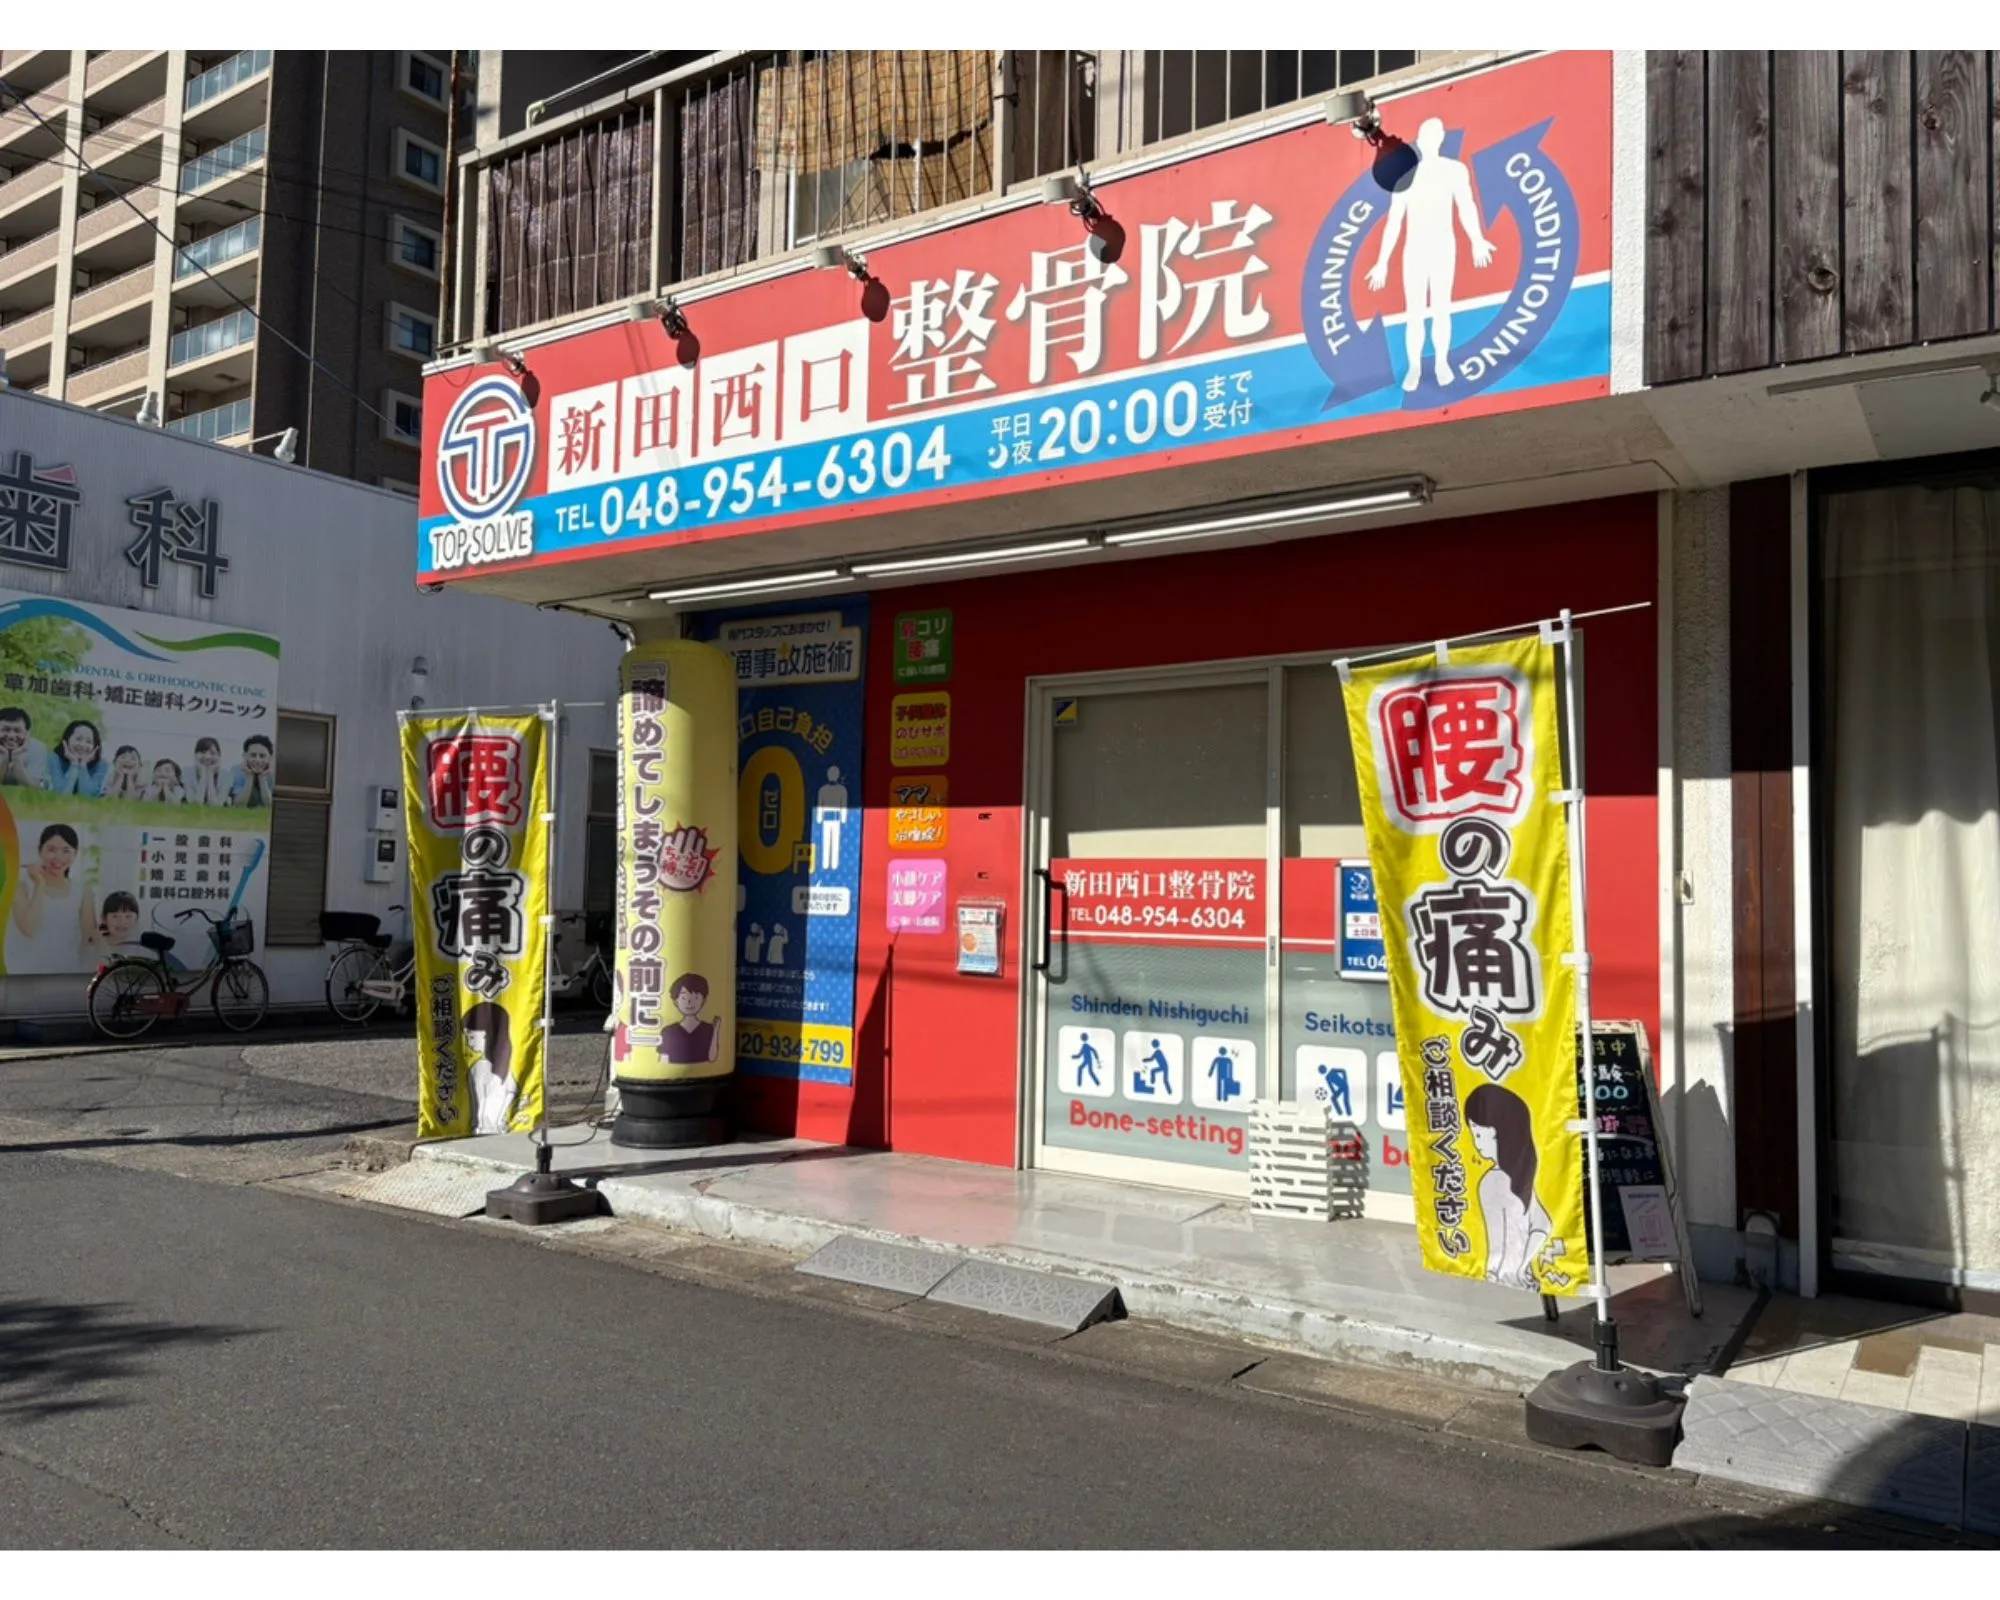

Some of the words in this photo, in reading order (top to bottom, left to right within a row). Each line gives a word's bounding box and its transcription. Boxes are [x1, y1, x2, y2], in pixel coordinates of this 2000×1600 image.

[1320, 200, 1374, 356] TRAINING
[1458, 152, 1561, 381] CONDITIONING
[1205, 370, 1254, 401] まで
[990, 412, 1031, 442] 平日
[1011, 440, 1033, 466] 夜
[1037, 379, 1198, 462] 20:00
[1203, 397, 1254, 432] 受付
[555, 504, 595, 534] TEL
[600, 425, 951, 537] 048-954-6304
[0, 450, 230, 597] 歯科
[75, 664, 121, 680] DENTAL
[124, 671, 135, 682] &
[229, 683, 267, 698] CLINIC
[429, 740, 522, 998] 腰の痛み
[1063, 869, 1256, 901] 新田西口整骨院
[1382, 680, 1528, 1080] 腰の痛み
[1070, 907, 1094, 922] TEL
[1095, 904, 1246, 929] 048-954-6304
[1347, 956, 1366, 966] TEL
[1071, 994, 1143, 1018] Shinden
[1148, 998, 1250, 1027] Nishiguchi
[1069, 1099, 1244, 1155] Bone-setting
[1420, 1036, 1471, 1258] ご相談ください
